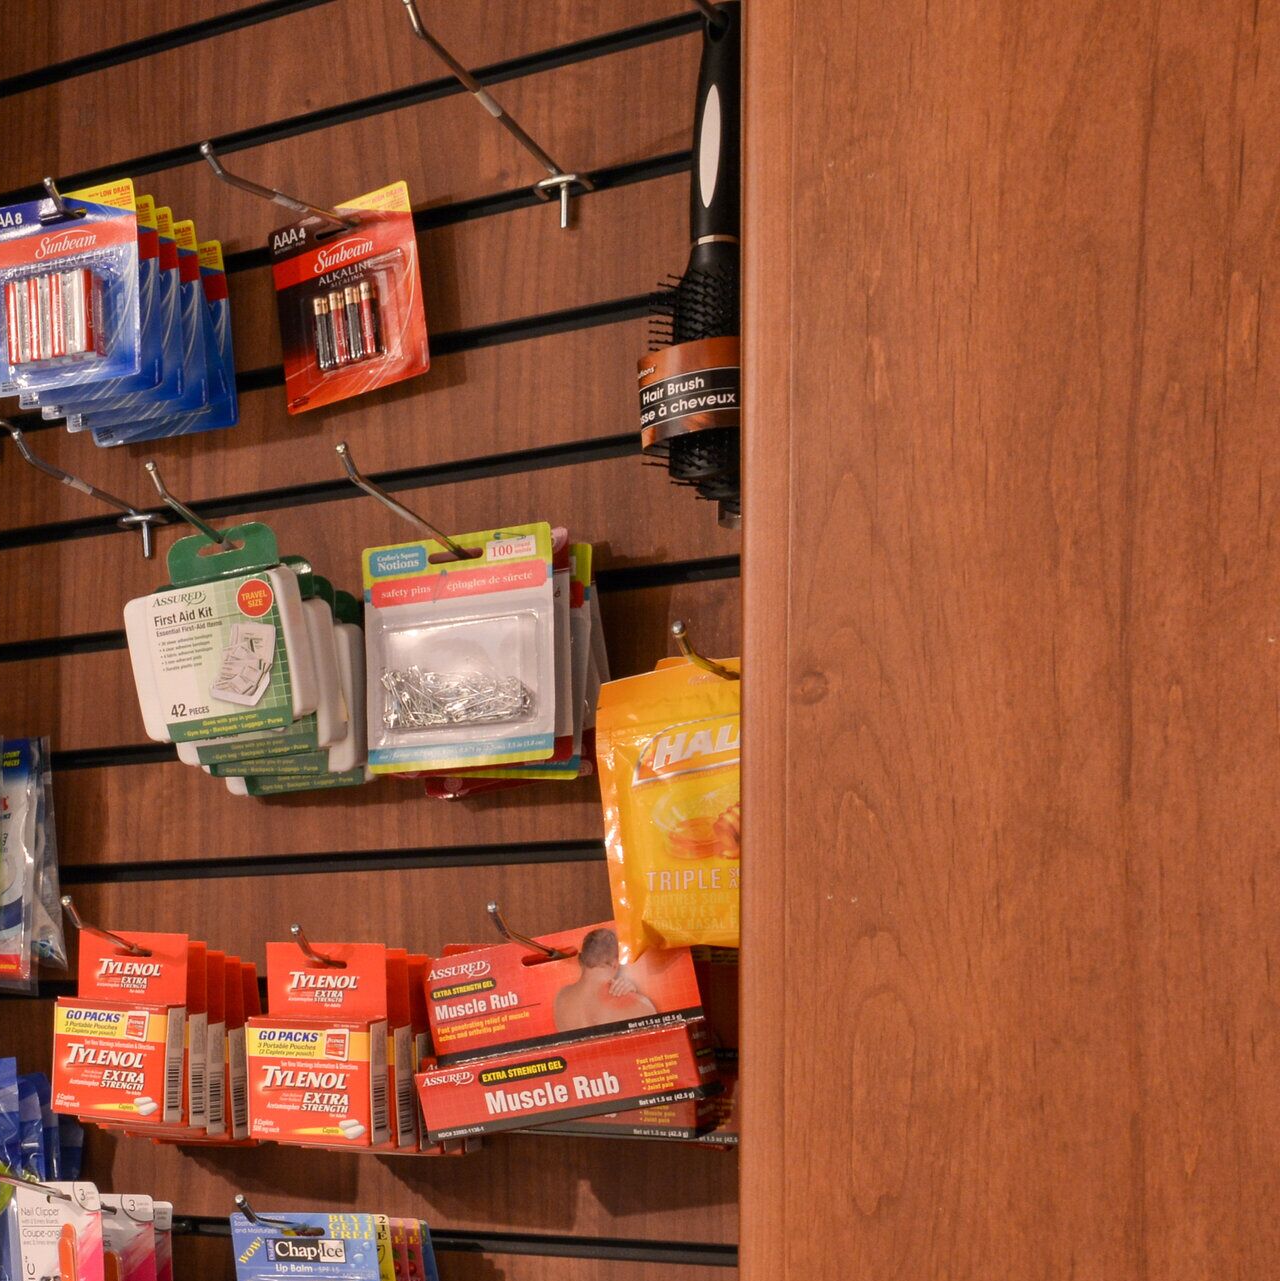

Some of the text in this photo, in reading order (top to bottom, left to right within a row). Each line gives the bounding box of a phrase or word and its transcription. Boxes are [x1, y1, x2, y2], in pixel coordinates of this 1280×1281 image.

[15, 213, 22, 224] 8
[35, 230, 97, 259] Sunbeam
[273, 227, 306, 250] AAA 4
[314, 238, 373, 274] Sunbeam
[318, 262, 373, 286] ALKALINE
[642, 377, 704, 405] Hair Brush
[658, 393, 735, 416] à cheveux
[492, 545, 513, 557] 100
[377, 558, 420, 571] Notions
[447, 571, 533, 592] épingles de sûreté
[152, 591, 207, 608] ASSURED
[240, 590, 268, 602] TRAVEL
[381, 585, 431, 599] safety pins
[247, 598, 263, 609] SIZE
[154, 606, 213, 627] First Aid Kit
[156, 627, 181, 638] Essential
[171, 704, 209, 718] 42 PIECES
[646, 868, 721, 892] TRIPLE
[99, 958, 161, 976] TYLENOL
[427, 961, 491, 981] ASSURED
[289, 971, 358, 989] TYLENOL
[315, 990, 343, 998] EXTRA
[433, 981, 493, 999] EXTRA STRENGTH GEL
[435, 991, 518, 1021] Muscle Rub
[66, 1010, 121, 1023] GO PACKS
[259, 1031, 318, 1043] GO PACKS
[67, 1043, 143, 1068] TYLENOL
[103, 1069, 144, 1083] EXTRA
[262, 1065, 348, 1089] TYLENOL
[423, 1060, 563, 1087] ASSURED EXTRA STRENGTH GEL
[100, 1080, 143, 1091] STRENGTH
[484, 1071, 620, 1115] Muscle Rub
[303, 1092, 349, 1105] EXTRA
[301, 1105, 348, 1113] STRENGTH
[21, 1207, 59, 1217] Nail Clipper
[239, 1236, 265, 1264] WOW!
[276, 1264, 313, 1272] Lip Balm
